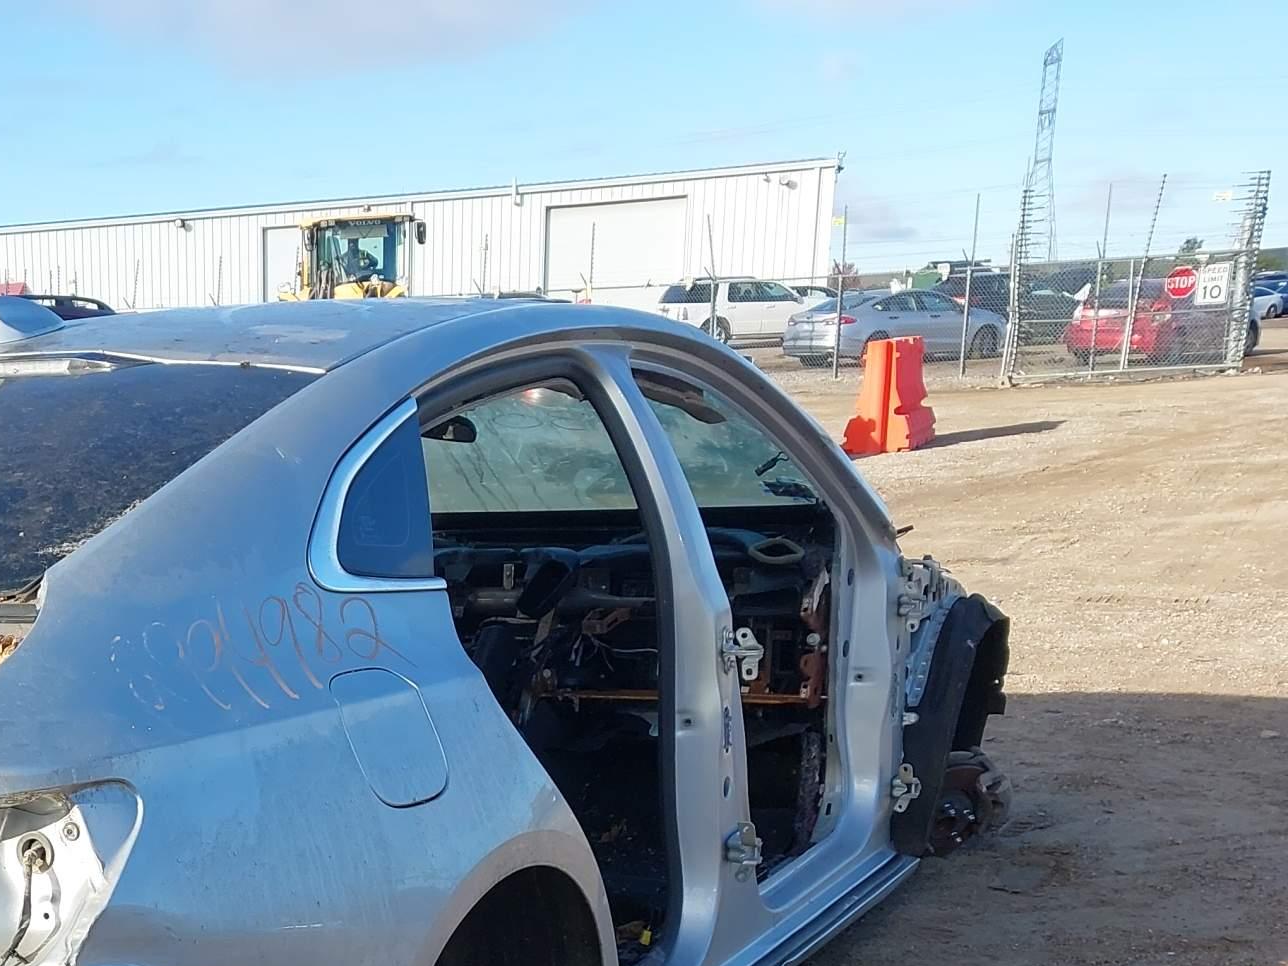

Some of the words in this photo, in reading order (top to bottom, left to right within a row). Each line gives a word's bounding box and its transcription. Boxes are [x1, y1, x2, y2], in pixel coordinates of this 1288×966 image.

[1200, 266, 1228, 274] SPEED
[1168, 276, 1196, 289] STOP
[1202, 285, 1222, 300] 10
